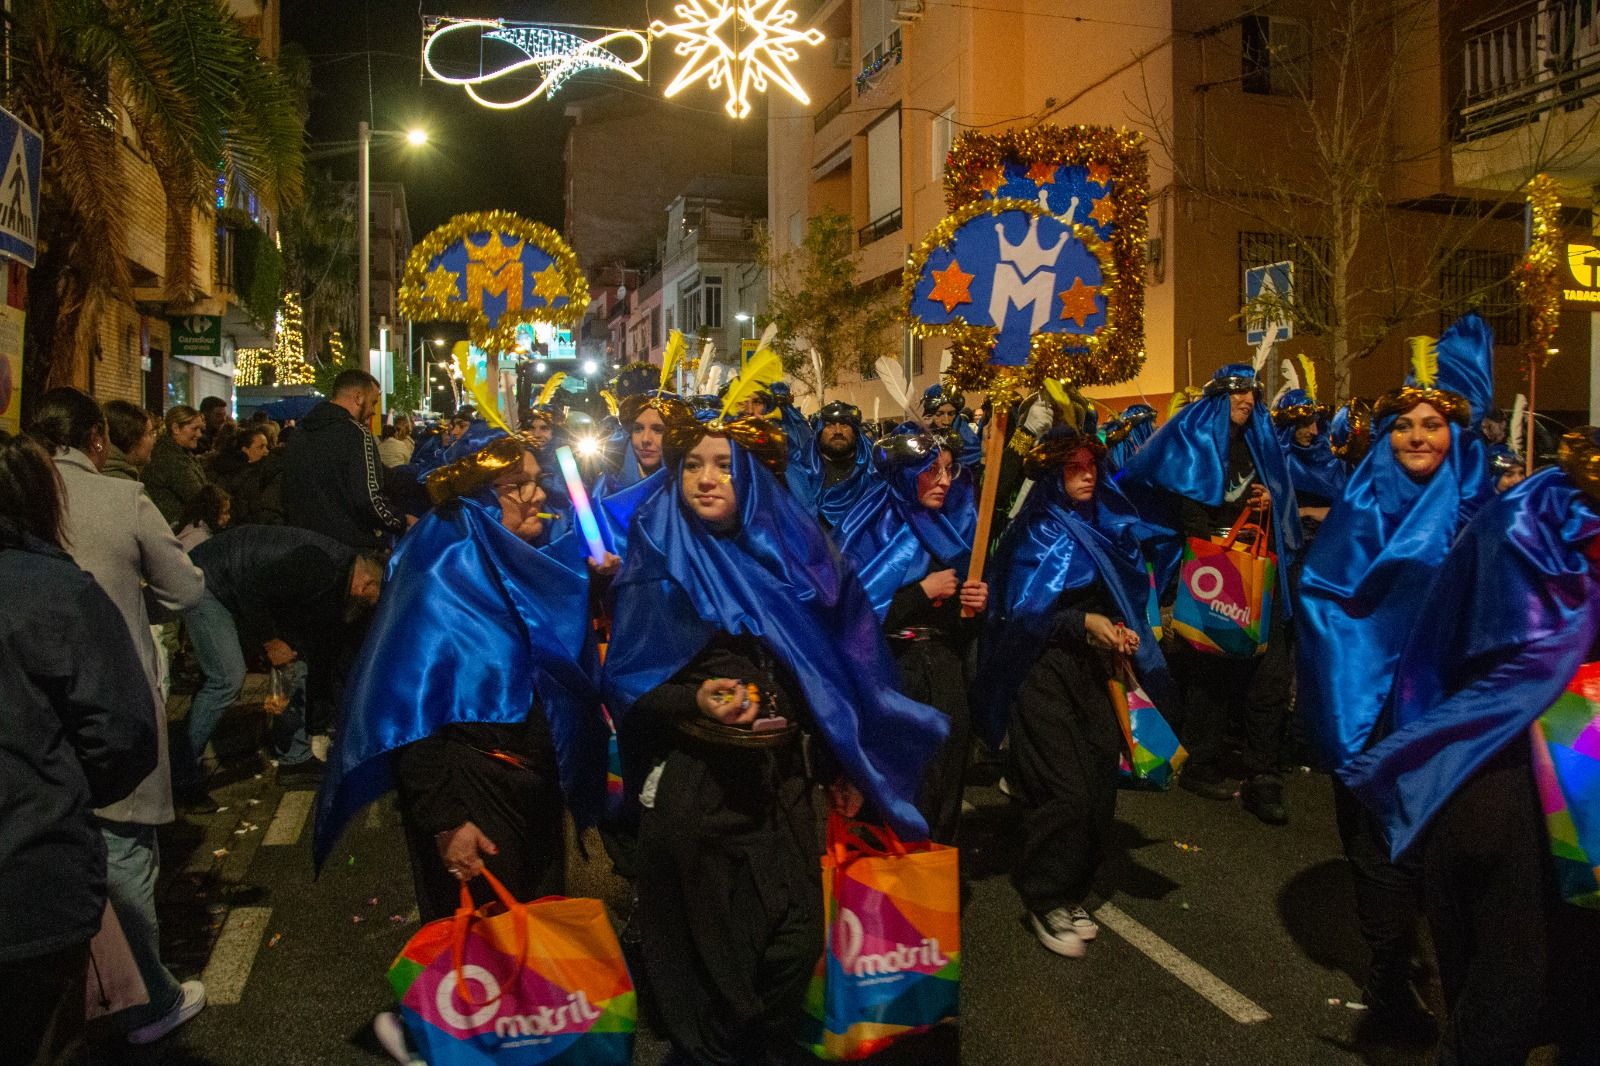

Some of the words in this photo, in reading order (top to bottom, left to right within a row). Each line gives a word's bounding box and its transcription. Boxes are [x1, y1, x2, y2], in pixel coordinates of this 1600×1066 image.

[466, 263, 524, 311] M
[989, 264, 1057, 335] M
[1210, 599, 1251, 625] motril
[855, 937, 949, 978] motril
[495, 990, 601, 1038] motril
